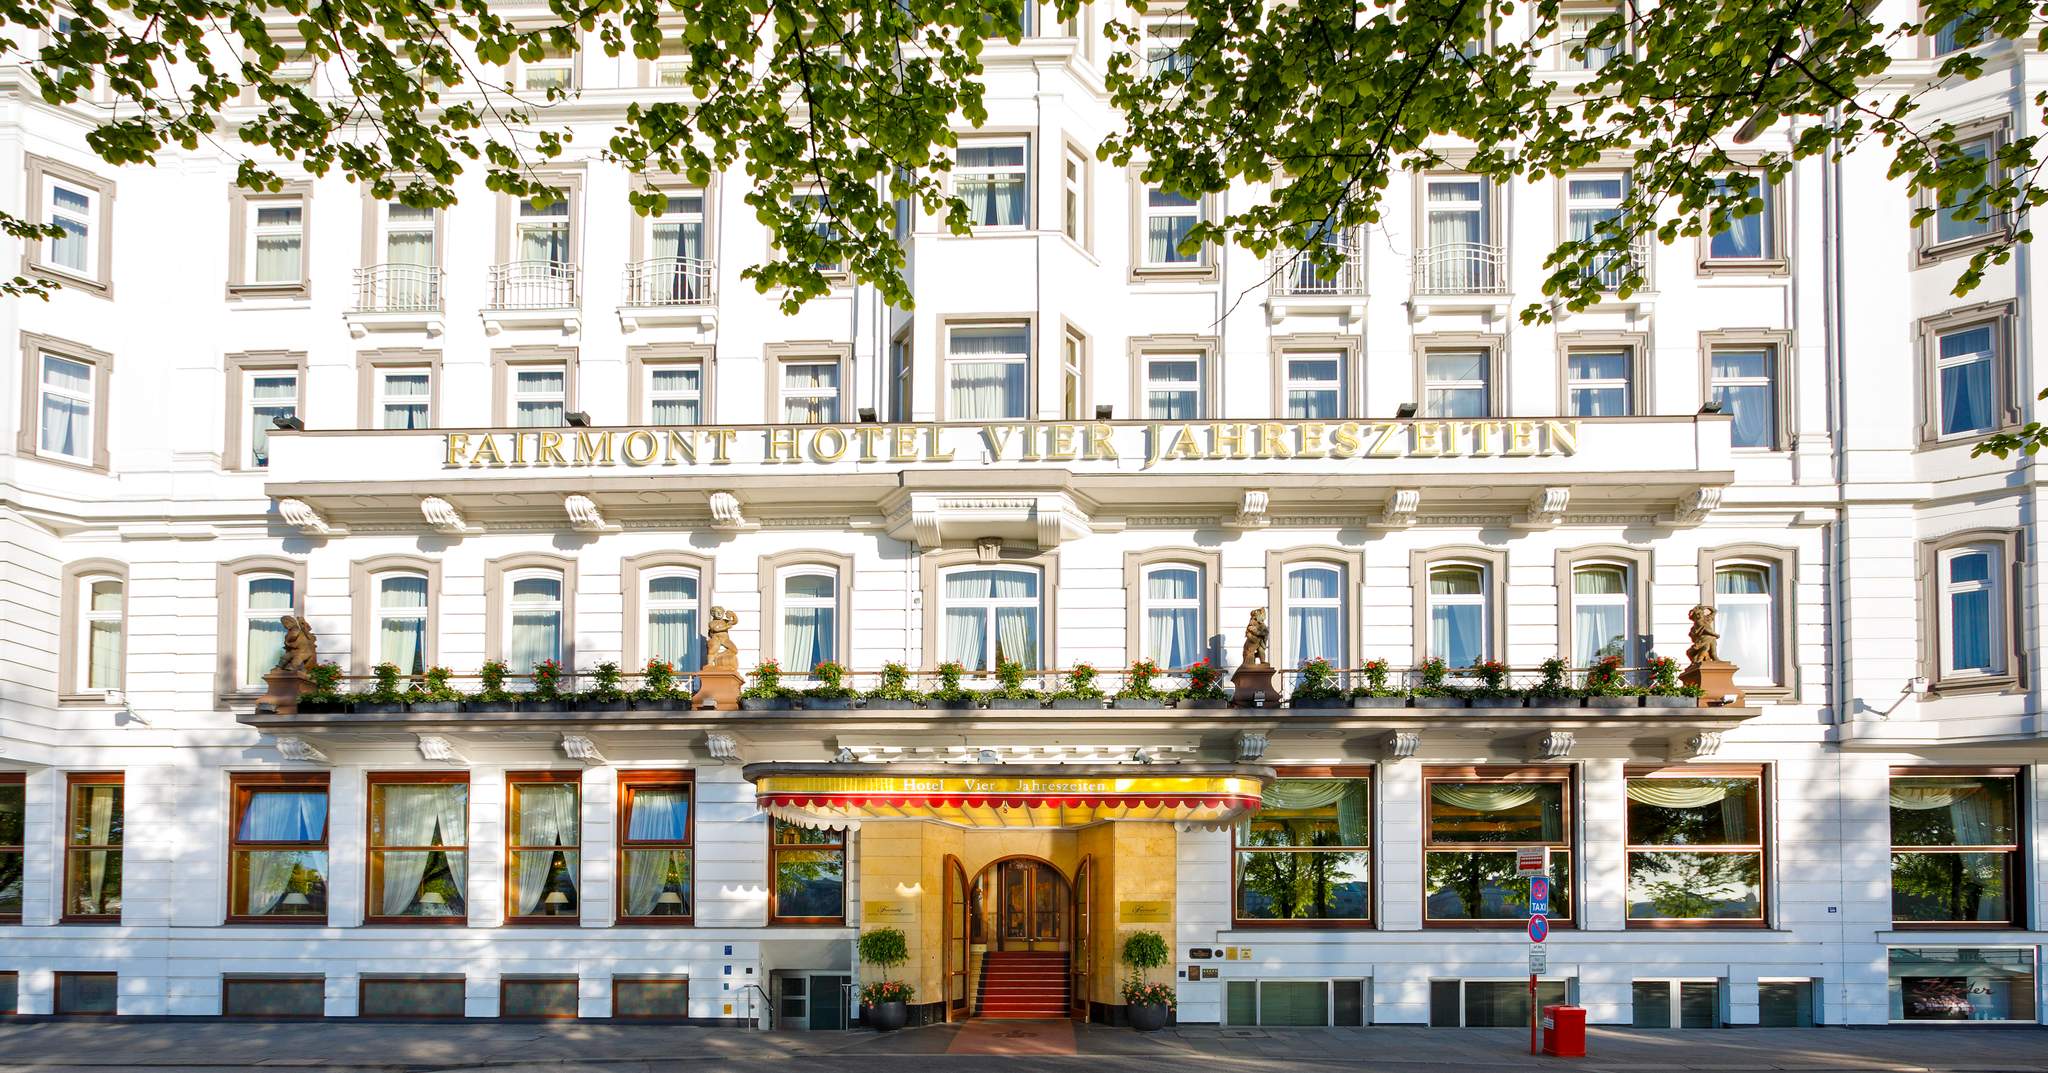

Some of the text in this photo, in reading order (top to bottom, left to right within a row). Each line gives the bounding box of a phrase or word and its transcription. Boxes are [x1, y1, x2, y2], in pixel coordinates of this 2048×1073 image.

[445, 421, 1582, 470] FAIRMONT HOTEL VIER JAHRESZEITEN
[904, 779, 1106, 792] Hotel Vier Jahreszeiten
[1532, 902, 1546, 911] TAXI
